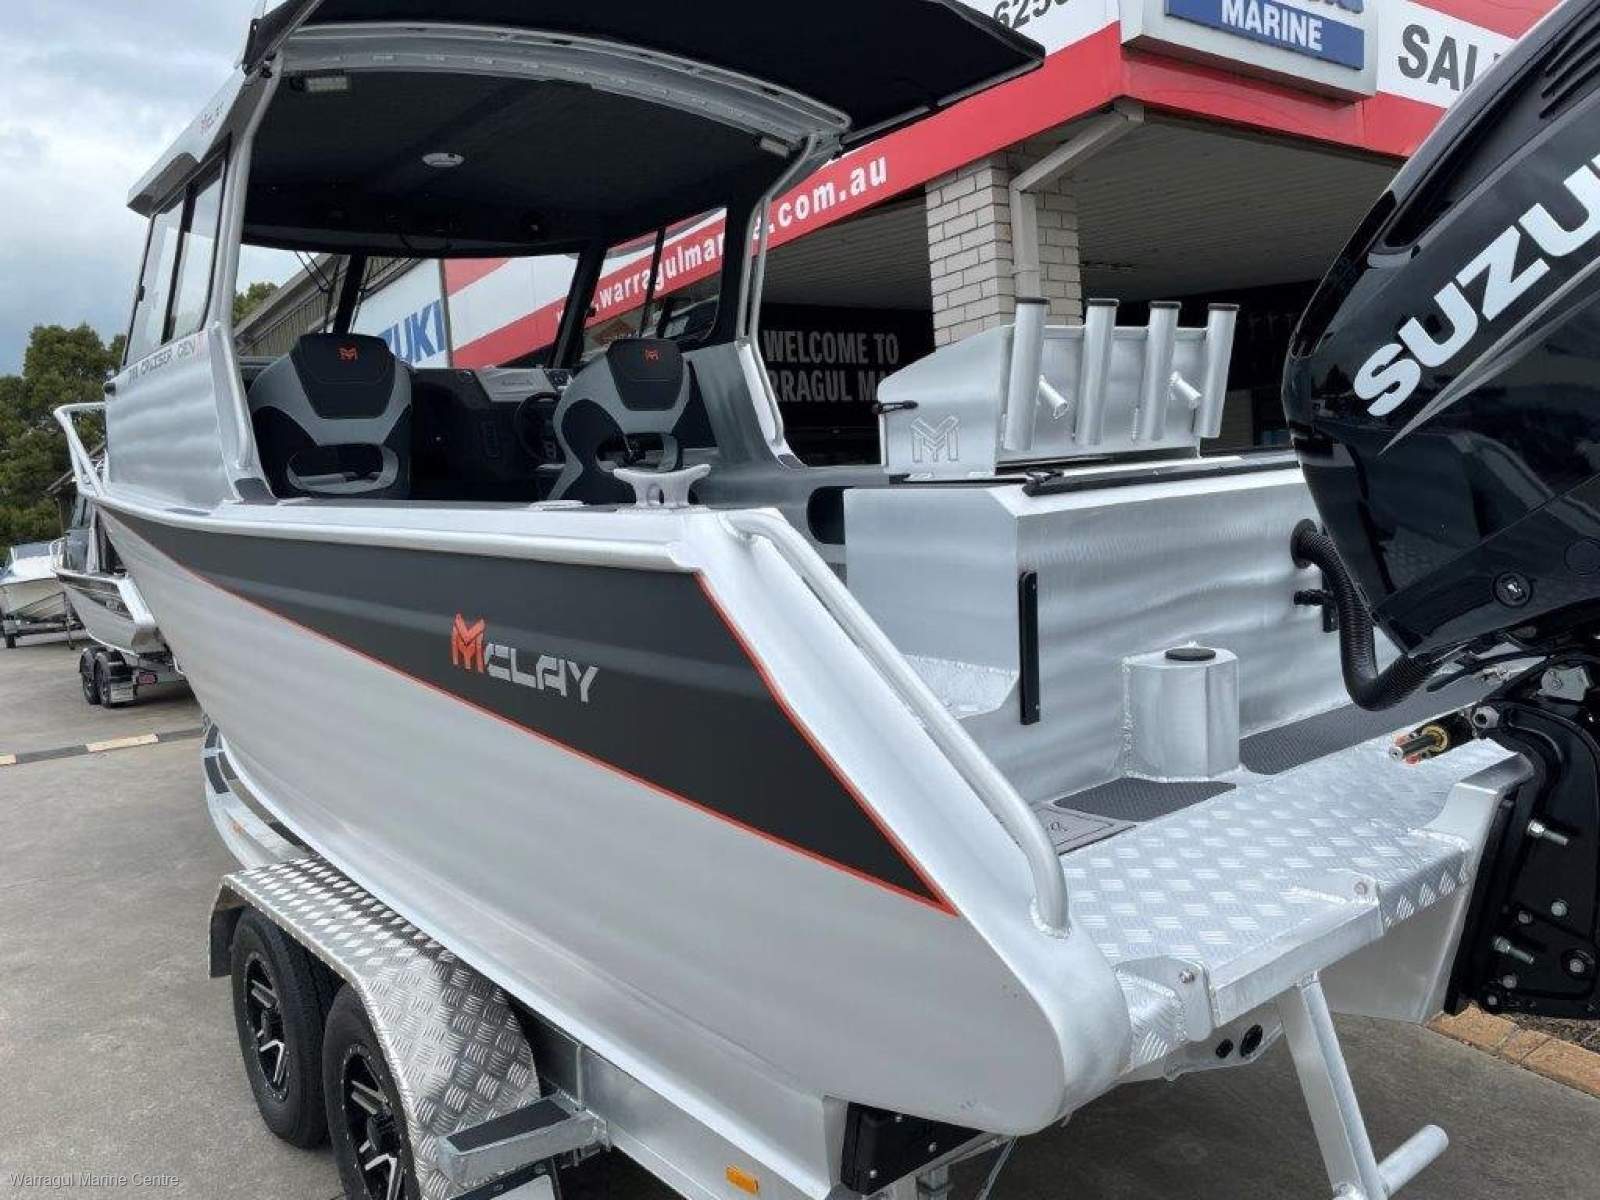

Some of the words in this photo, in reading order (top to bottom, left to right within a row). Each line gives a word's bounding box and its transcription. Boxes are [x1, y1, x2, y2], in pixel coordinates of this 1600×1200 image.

[992, 0, 1068, 29] 625
[1221, 0, 1323, 51] MARINE
[1353, 153, 1600, 417] SUZU
[763, 330, 869, 364] WELCOME
[873, 332, 900, 364] TO
[767, 369, 853, 403] RRAGUL
